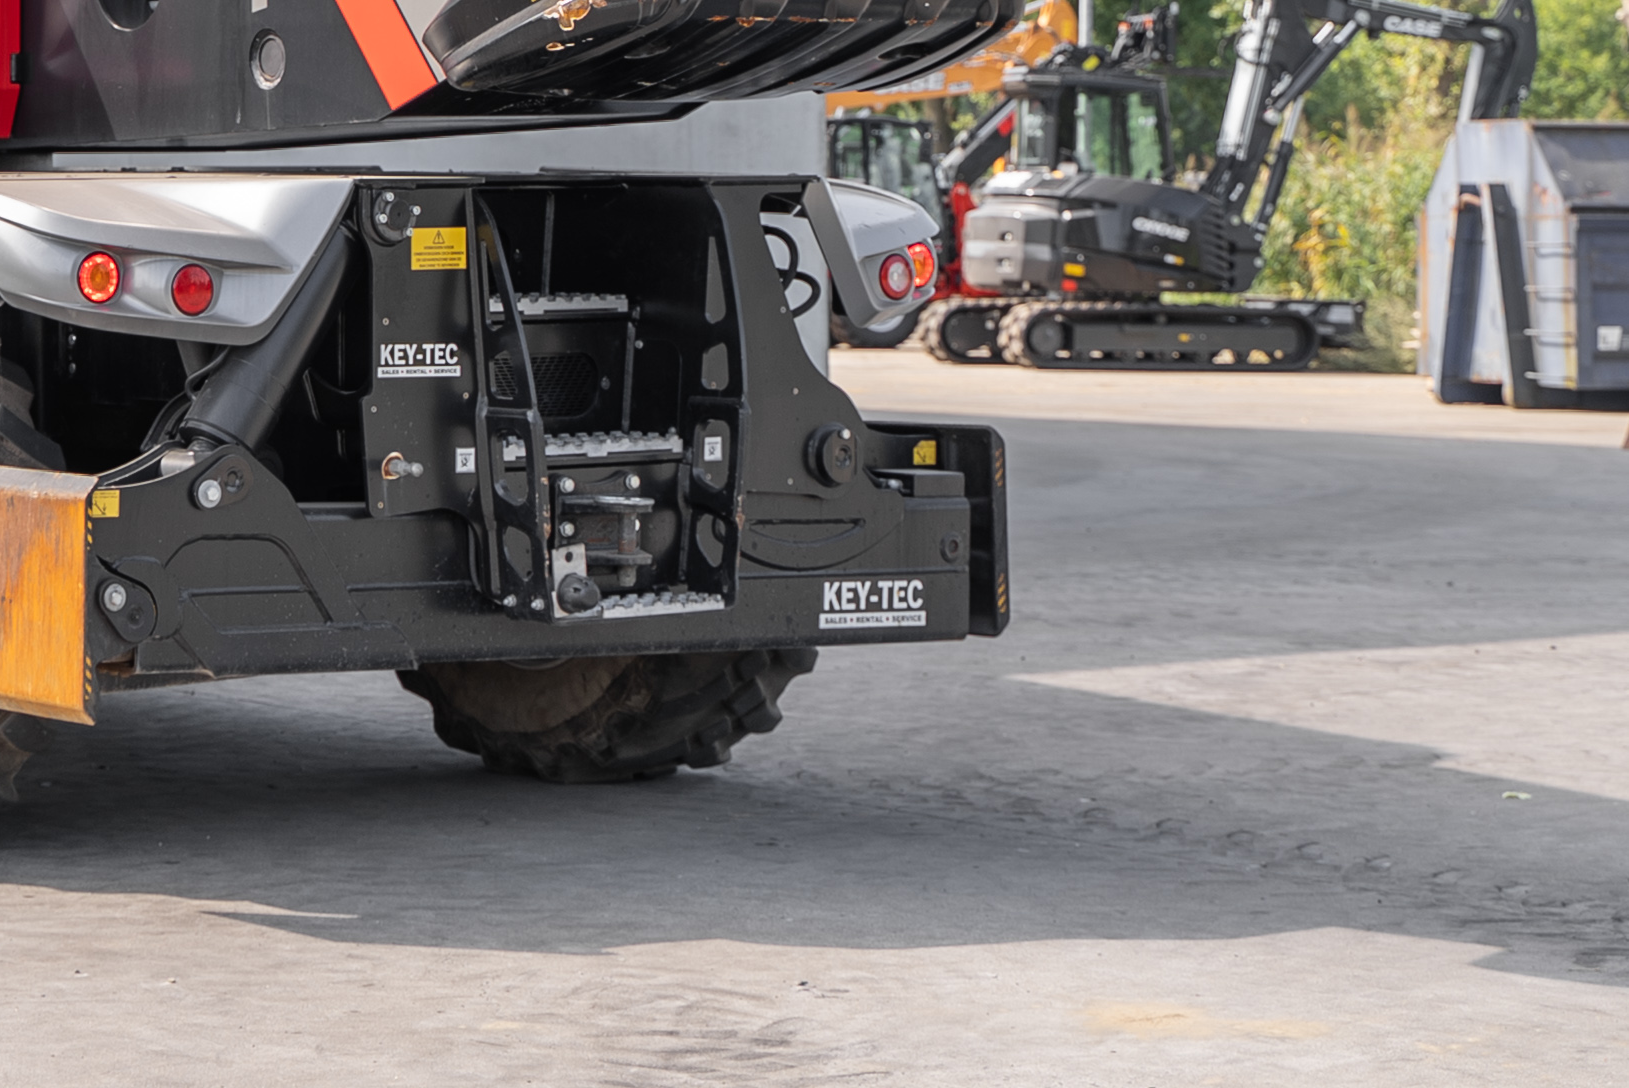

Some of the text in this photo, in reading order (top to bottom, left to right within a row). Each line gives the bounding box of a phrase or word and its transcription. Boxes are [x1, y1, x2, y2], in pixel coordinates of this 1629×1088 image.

[379, 343, 459, 365] KEY-TEC
[823, 579, 924, 611] KEY-TEC
[824, 614, 922, 625] SALES RENTAL SERVICE
